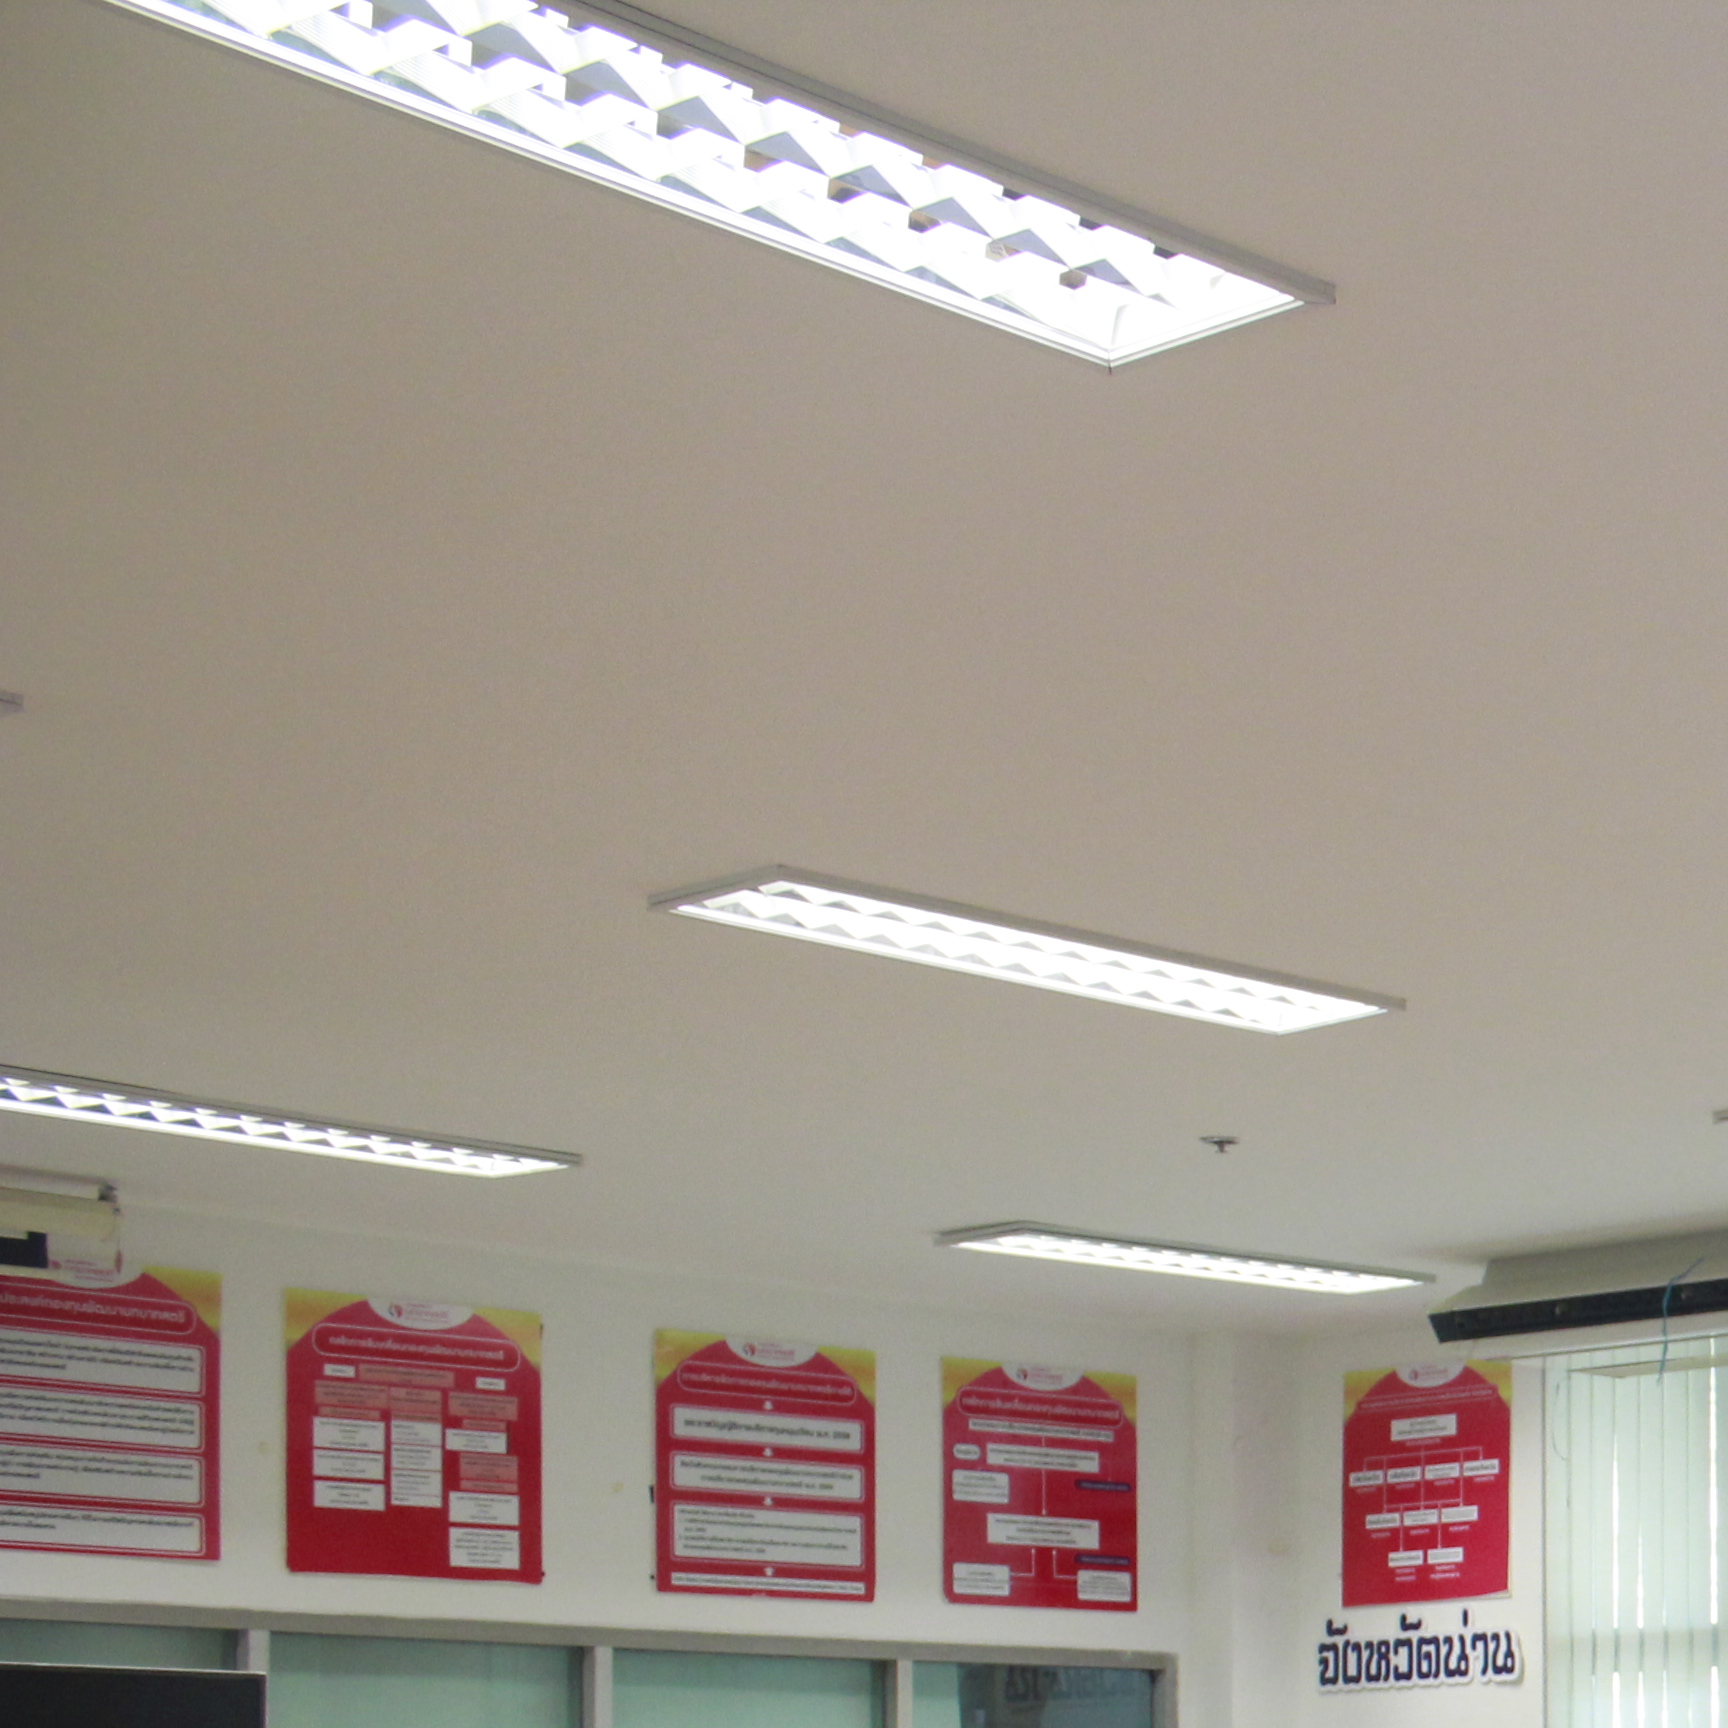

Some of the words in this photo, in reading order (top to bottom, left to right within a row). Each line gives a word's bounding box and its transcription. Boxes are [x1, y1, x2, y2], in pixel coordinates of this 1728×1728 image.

[1317, 1609, 1516, 1687] จังหวัดน่าน
